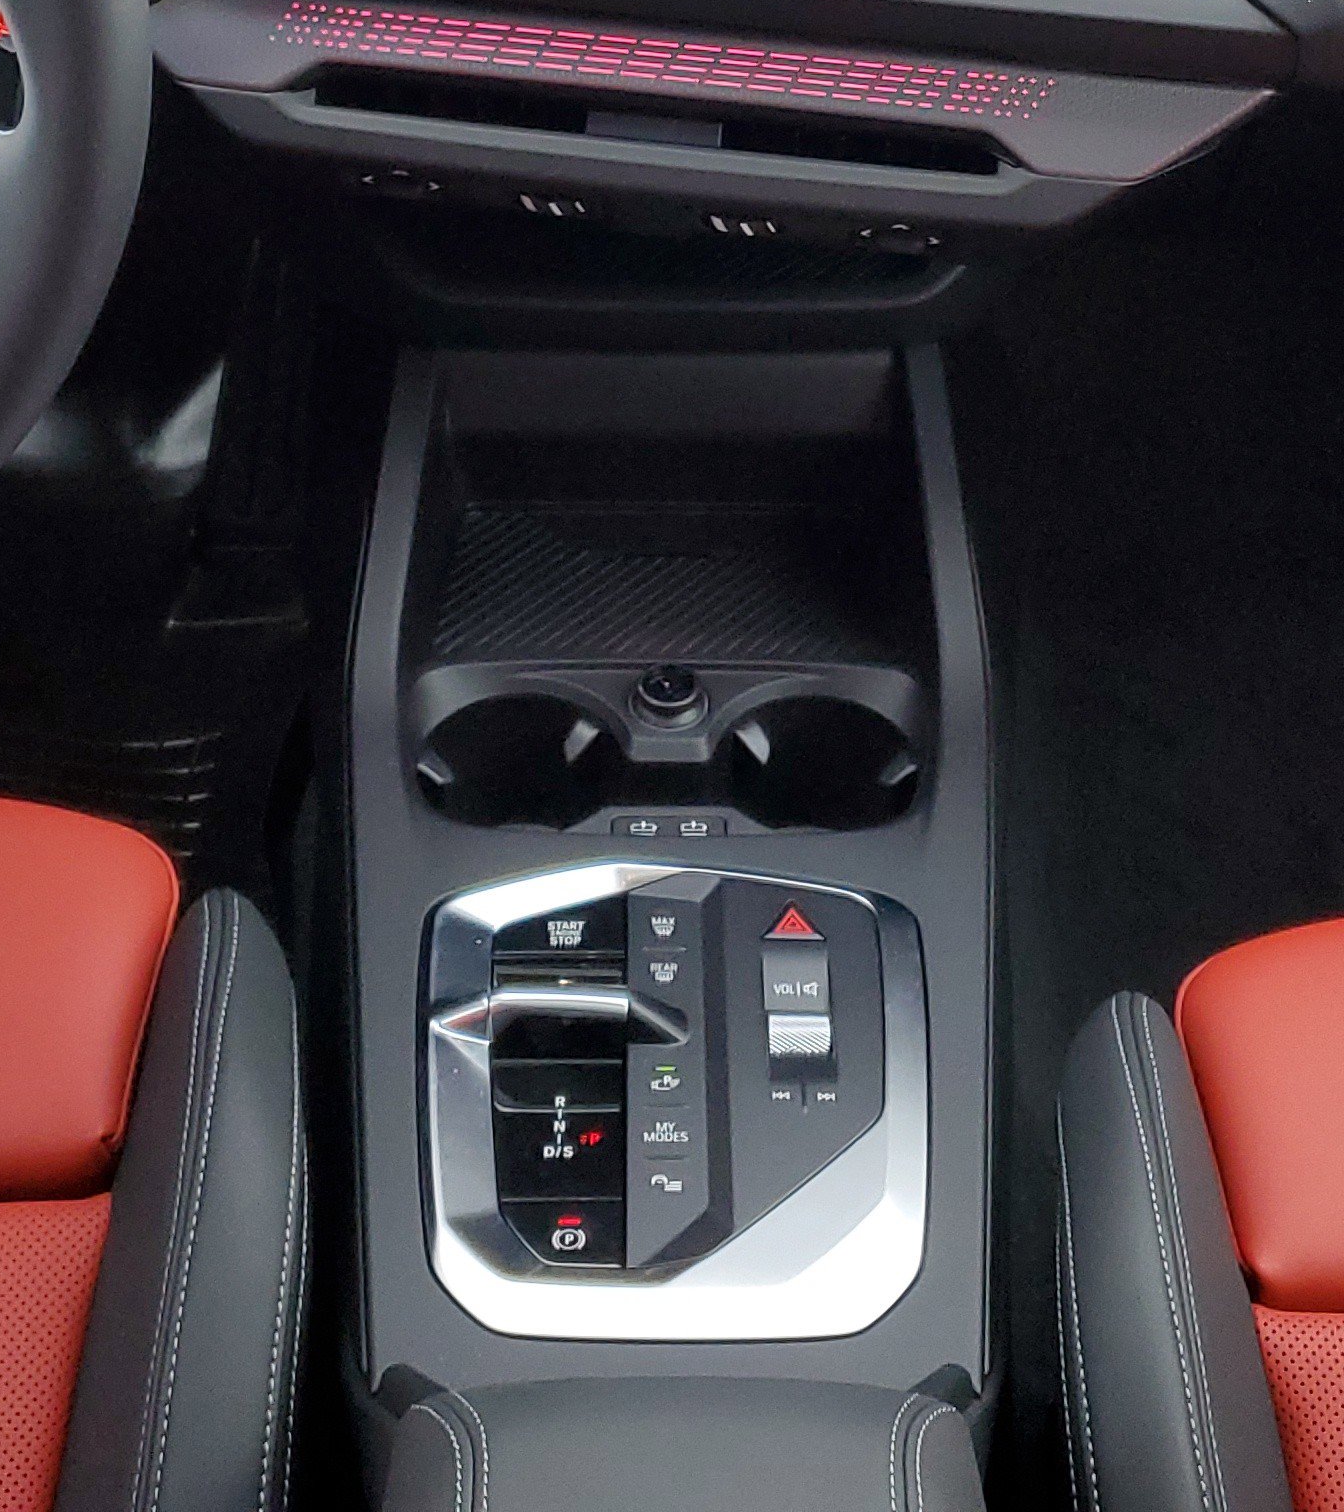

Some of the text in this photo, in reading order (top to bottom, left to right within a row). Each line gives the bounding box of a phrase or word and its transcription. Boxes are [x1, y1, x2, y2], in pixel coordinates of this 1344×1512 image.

[547, 920, 586, 930] START
[650, 916, 676, 926] MAX
[550, 936, 582, 949] STOP
[772, 983, 795, 996] VOL
[555, 1096, 566, 1108] R
[554, 1120, 566, 1132] N
[656, 1122, 676, 1132] MY
[643, 1131, 689, 1142] MODES
[542, 1145, 574, 1158] D/S
